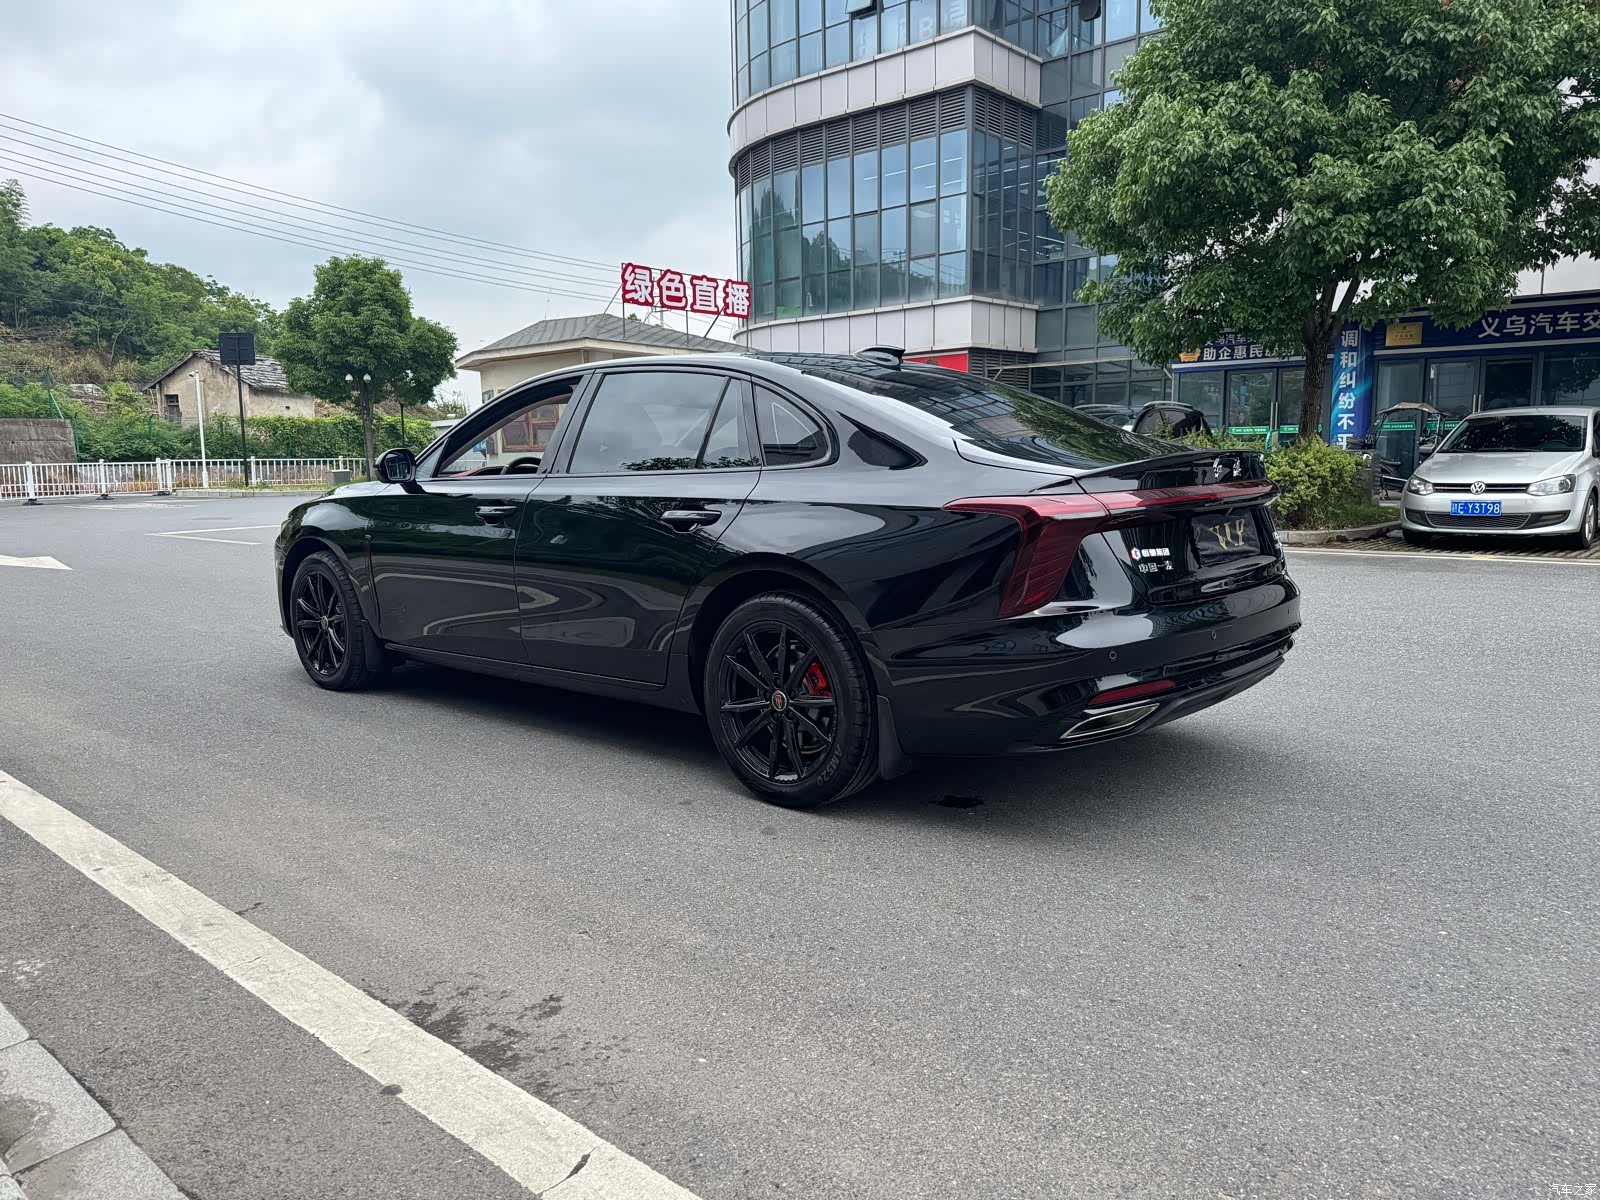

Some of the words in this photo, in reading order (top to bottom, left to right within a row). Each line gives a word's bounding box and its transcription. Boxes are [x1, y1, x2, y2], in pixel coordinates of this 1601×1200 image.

[622, 264, 751, 319] 绿色直播
[1337, 330, 1359, 450] 调和纠纷不平
